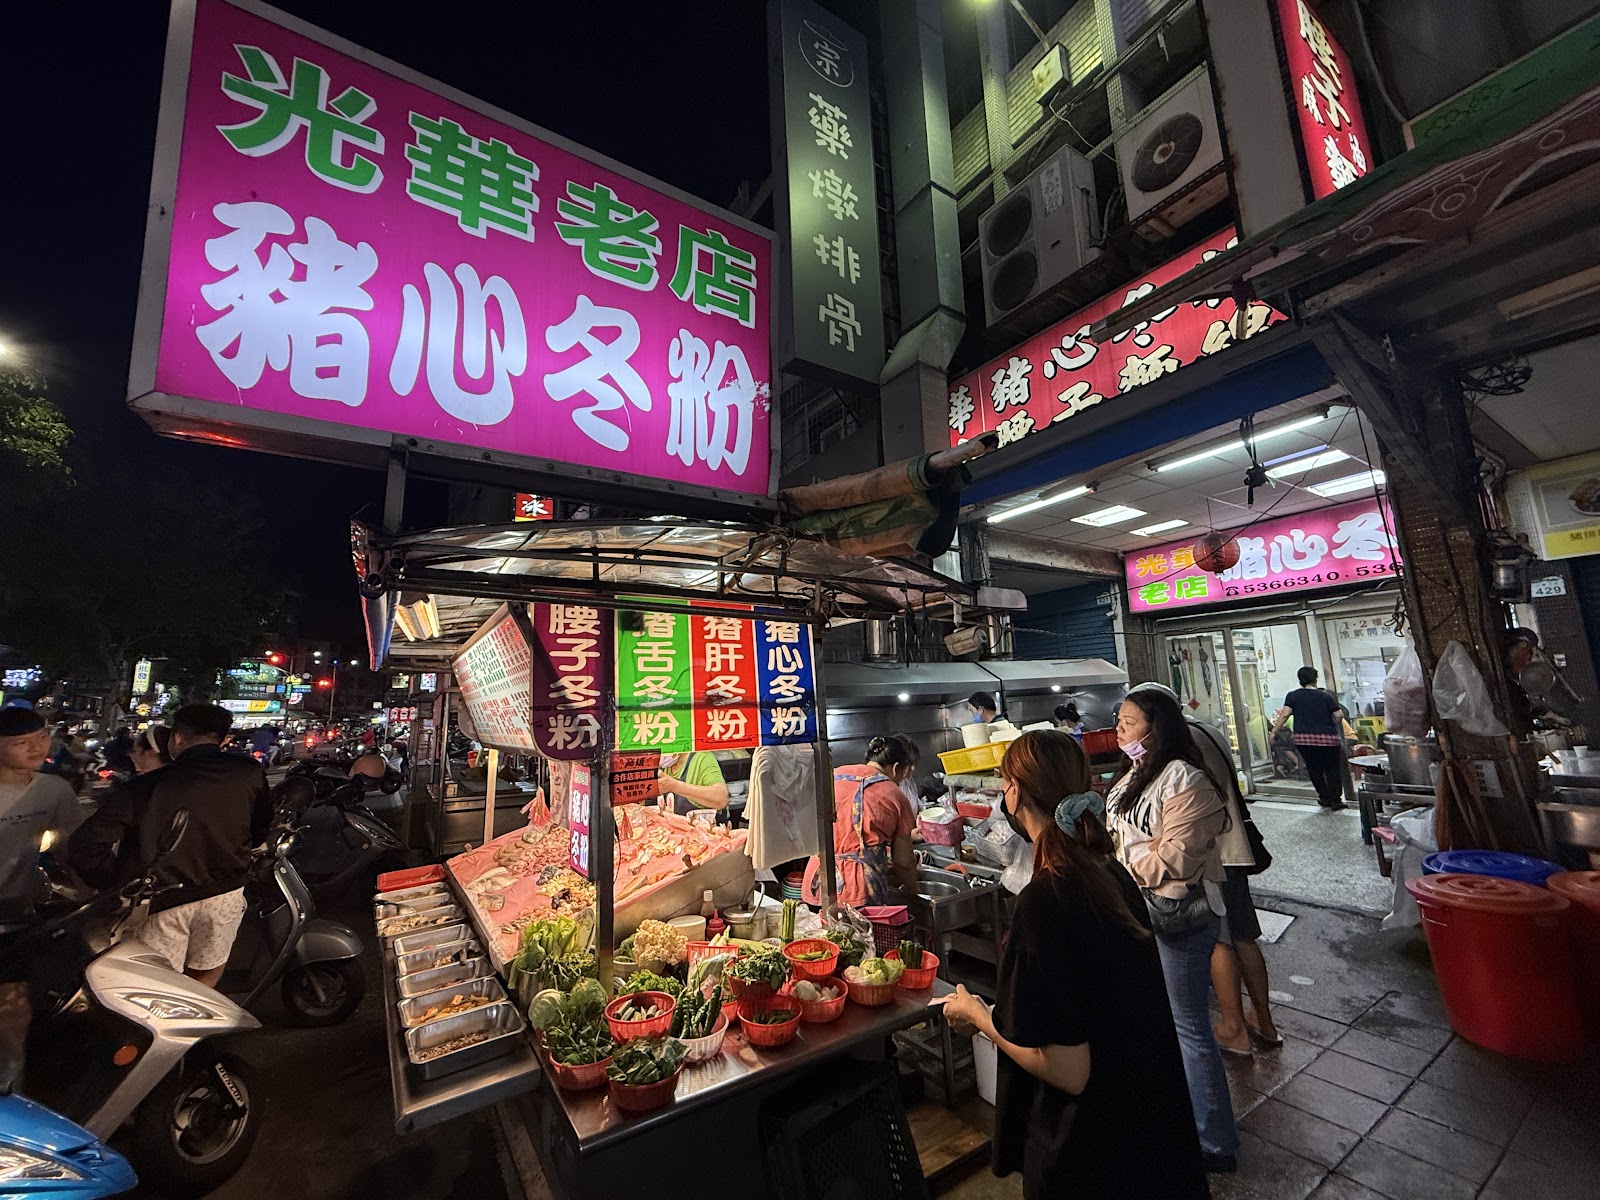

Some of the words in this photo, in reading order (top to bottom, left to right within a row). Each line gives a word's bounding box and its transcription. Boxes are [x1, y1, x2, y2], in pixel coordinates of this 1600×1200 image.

[216, 43, 757, 329] 光華老店
[808, 92, 862, 352] 藥燉排骨
[196, 201, 754, 475] 豬心冬粉
[547, 603, 601, 750] 腰子冬粉
[1139, 575, 1208, 605] 老店
[1536, 585, 1562, 595] 429
